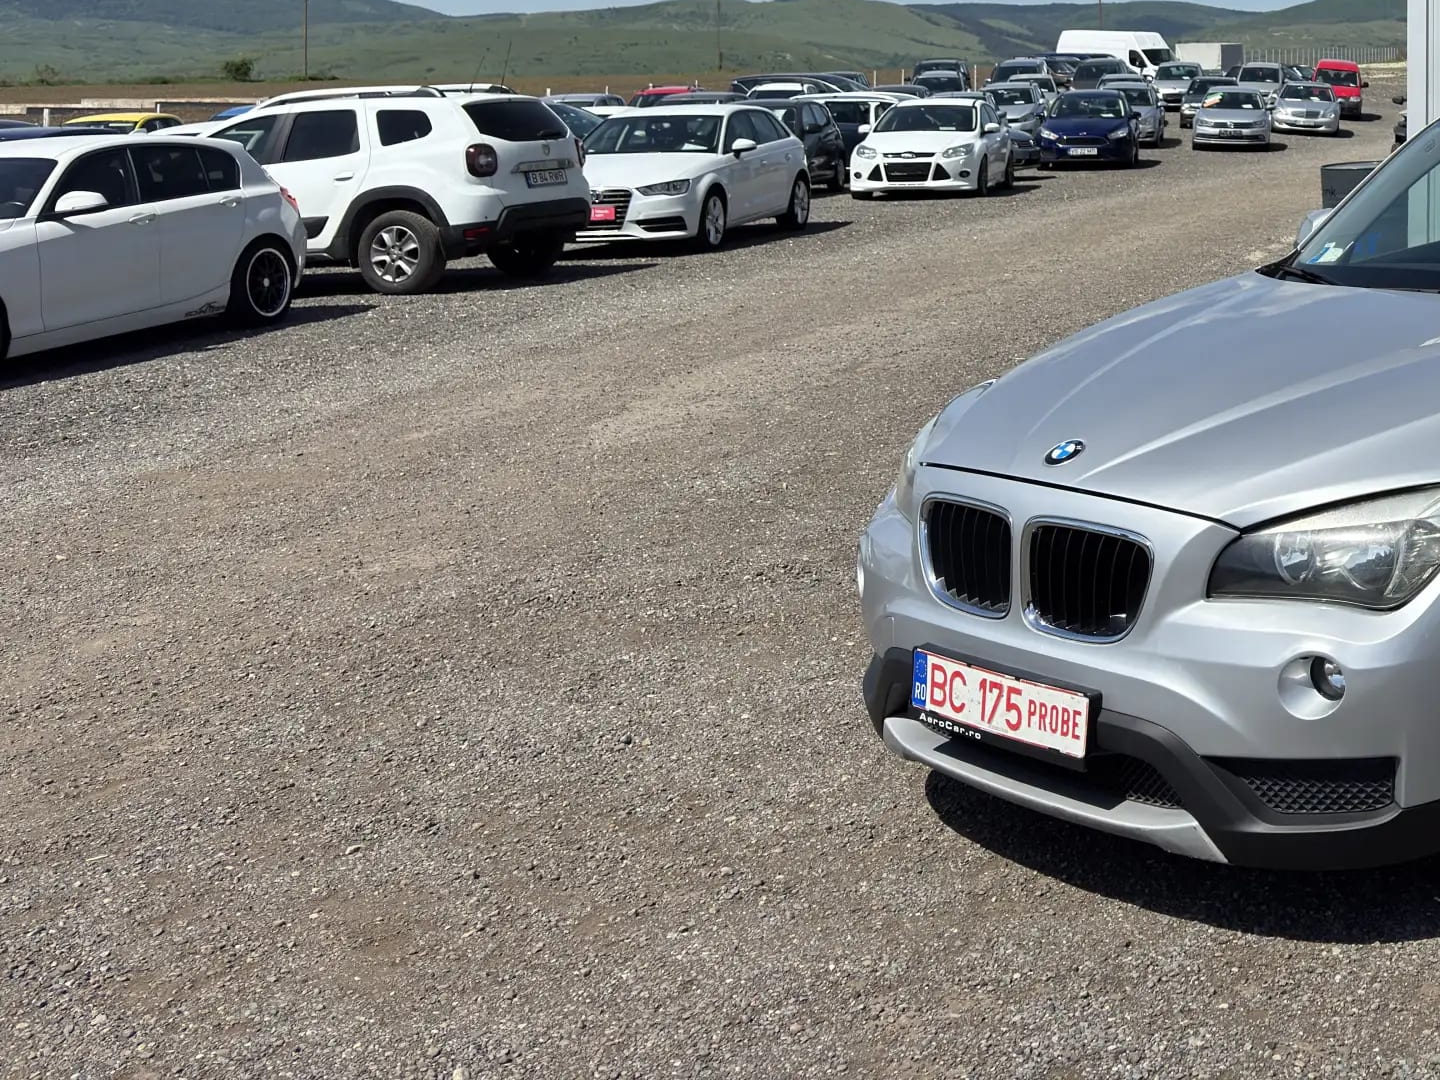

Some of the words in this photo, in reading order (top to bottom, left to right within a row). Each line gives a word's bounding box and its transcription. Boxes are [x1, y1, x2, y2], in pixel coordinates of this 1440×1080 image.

[914, 682, 926, 701] RO
[929, 662, 967, 713] BC
[978, 678, 1023, 732] 175
[1027, 698, 1082, 740] PROBE
[919, 712, 982, 740] AeroCar.ro
